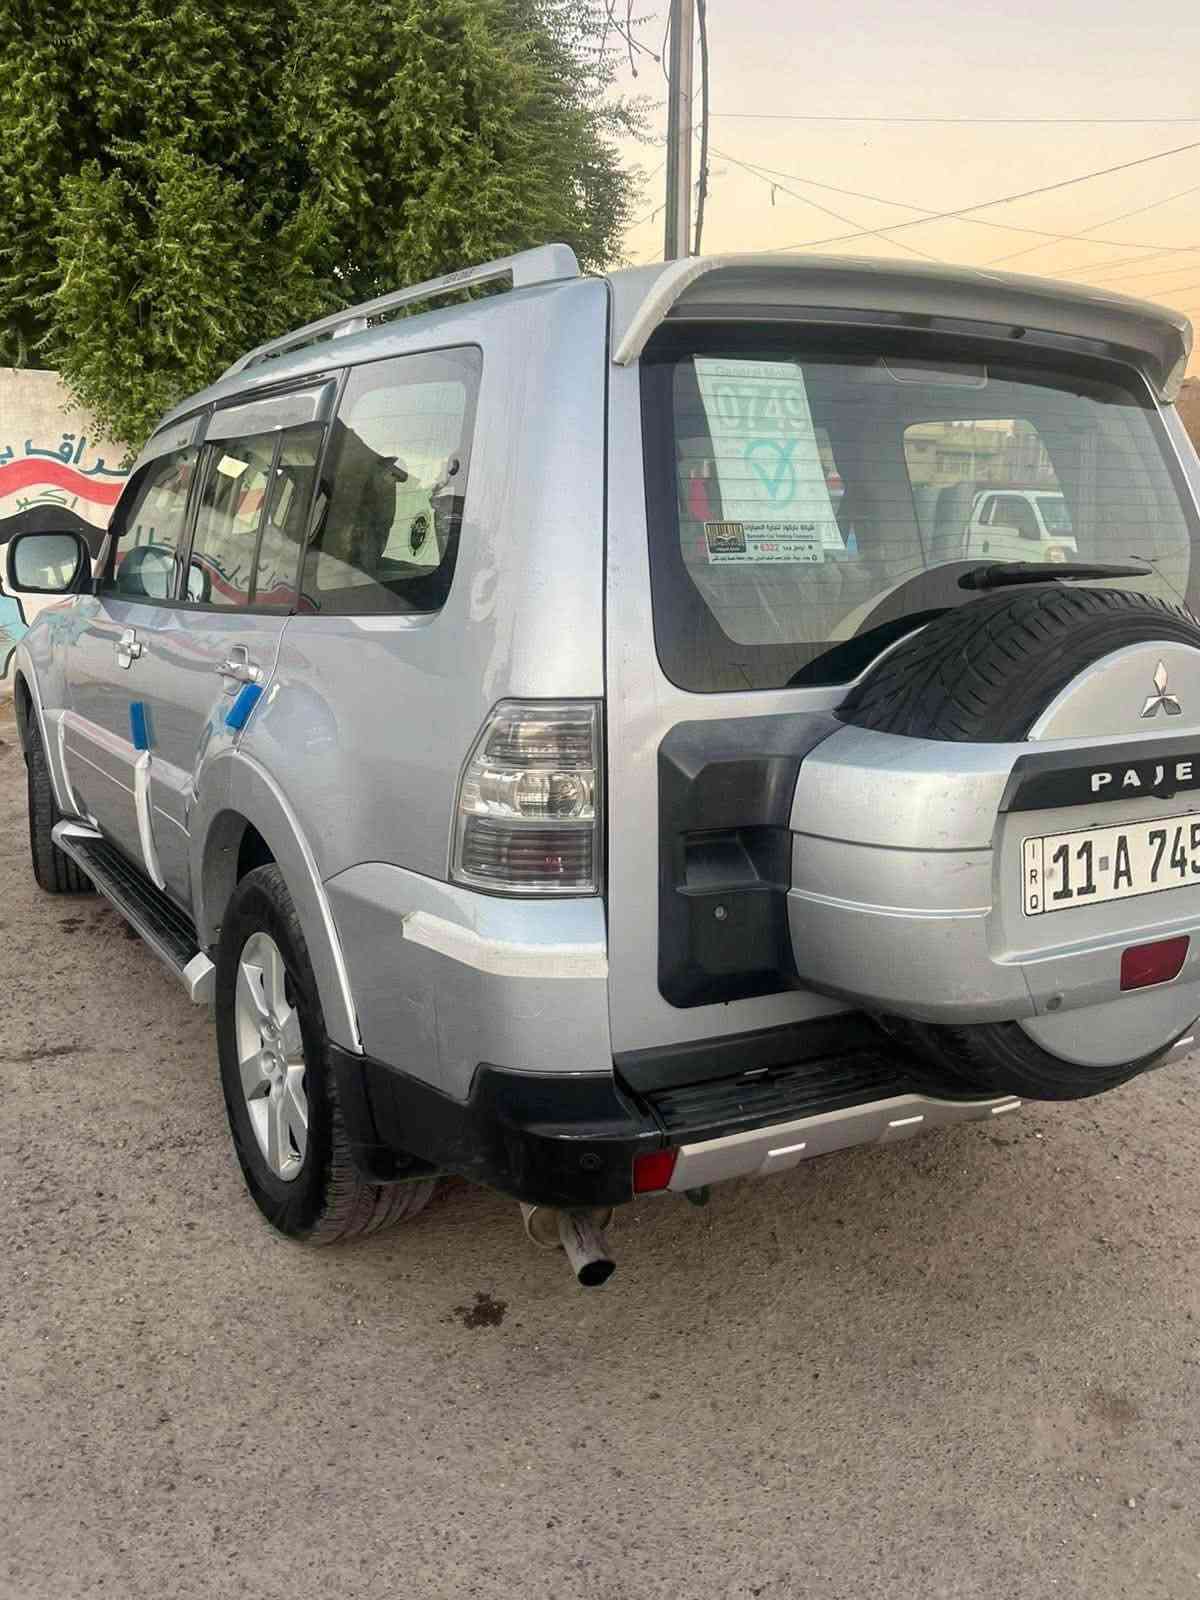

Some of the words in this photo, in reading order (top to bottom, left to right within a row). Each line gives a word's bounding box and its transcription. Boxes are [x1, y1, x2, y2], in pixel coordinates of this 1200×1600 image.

[1091, 762, 1193, 792] PAJE
[1052, 840, 1097, 900] 11
[1113, 835, 1134, 890] A
